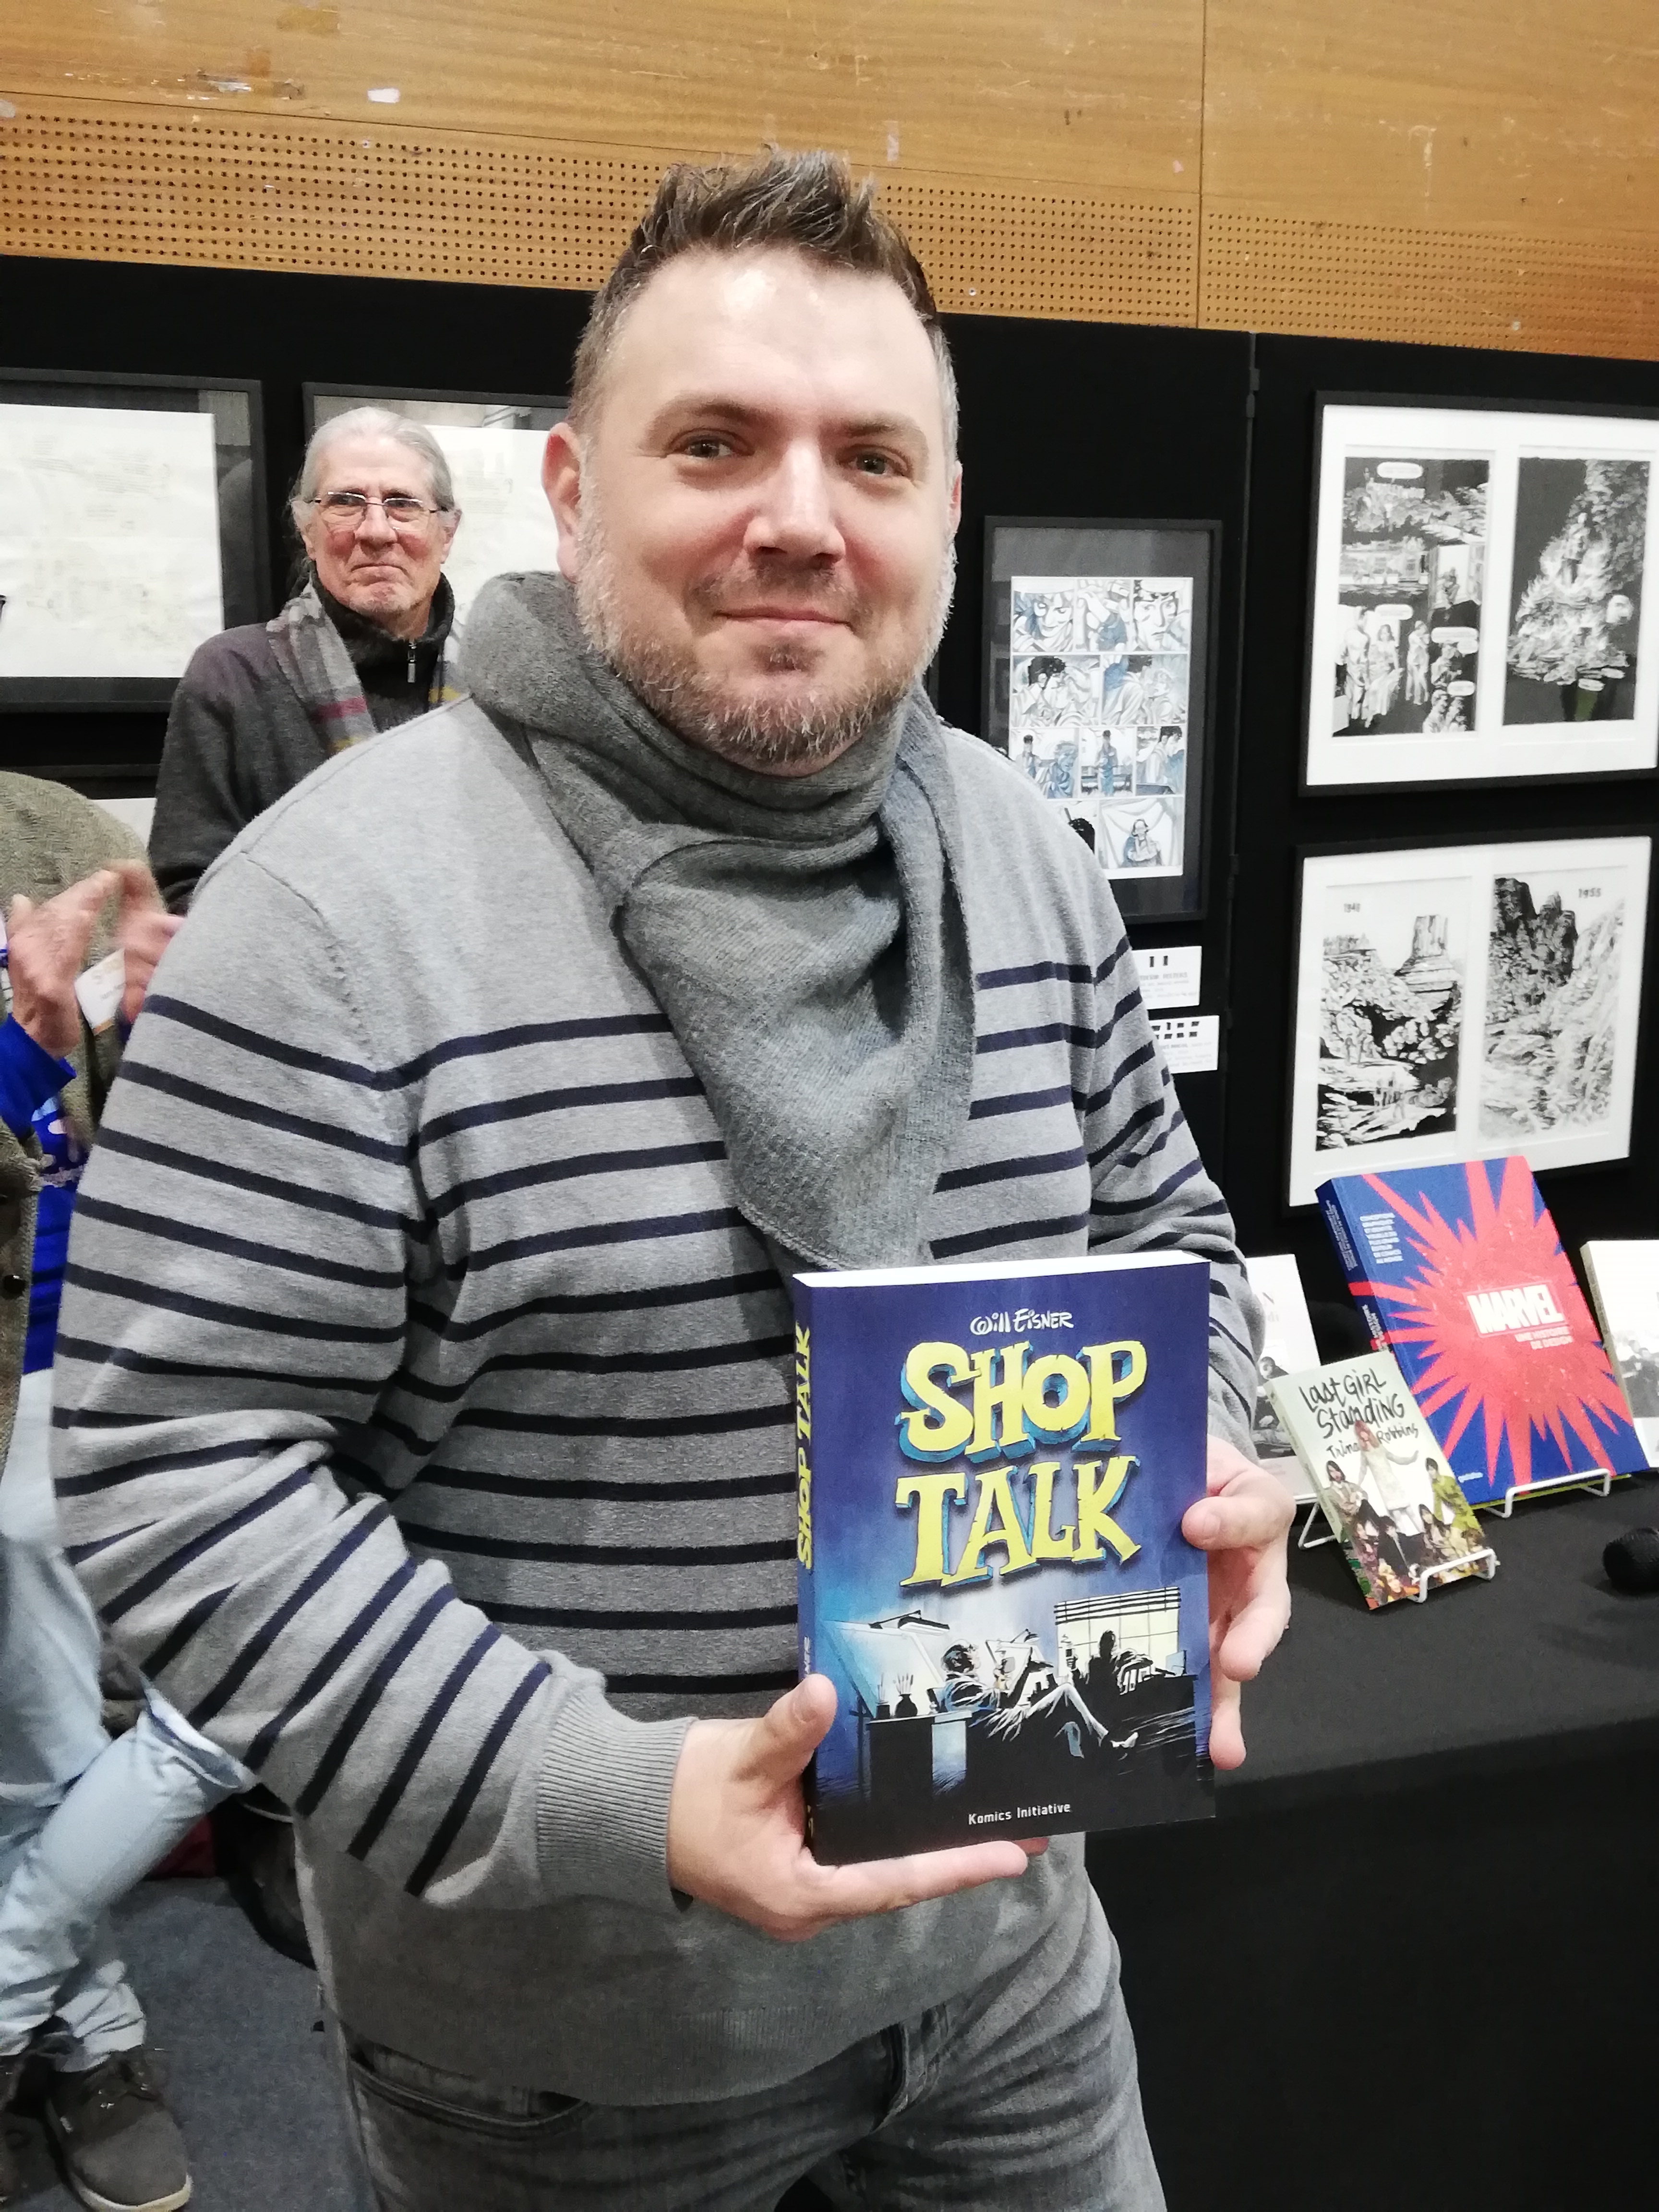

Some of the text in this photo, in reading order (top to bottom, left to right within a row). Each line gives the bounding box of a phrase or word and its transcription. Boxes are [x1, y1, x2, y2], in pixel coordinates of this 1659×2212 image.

[970, 1311, 1011, 1335] Will
[1467, 1285, 1564, 1334] MARVEL
[895, 1341, 1147, 1463] SHOP
[1298, 1377, 1346, 1412] Last
[795, 1320, 811, 1570] SHOP TALK
[895, 1456, 1141, 1587] TALK
[968, 1803, 1071, 1825] Komics Initiative
